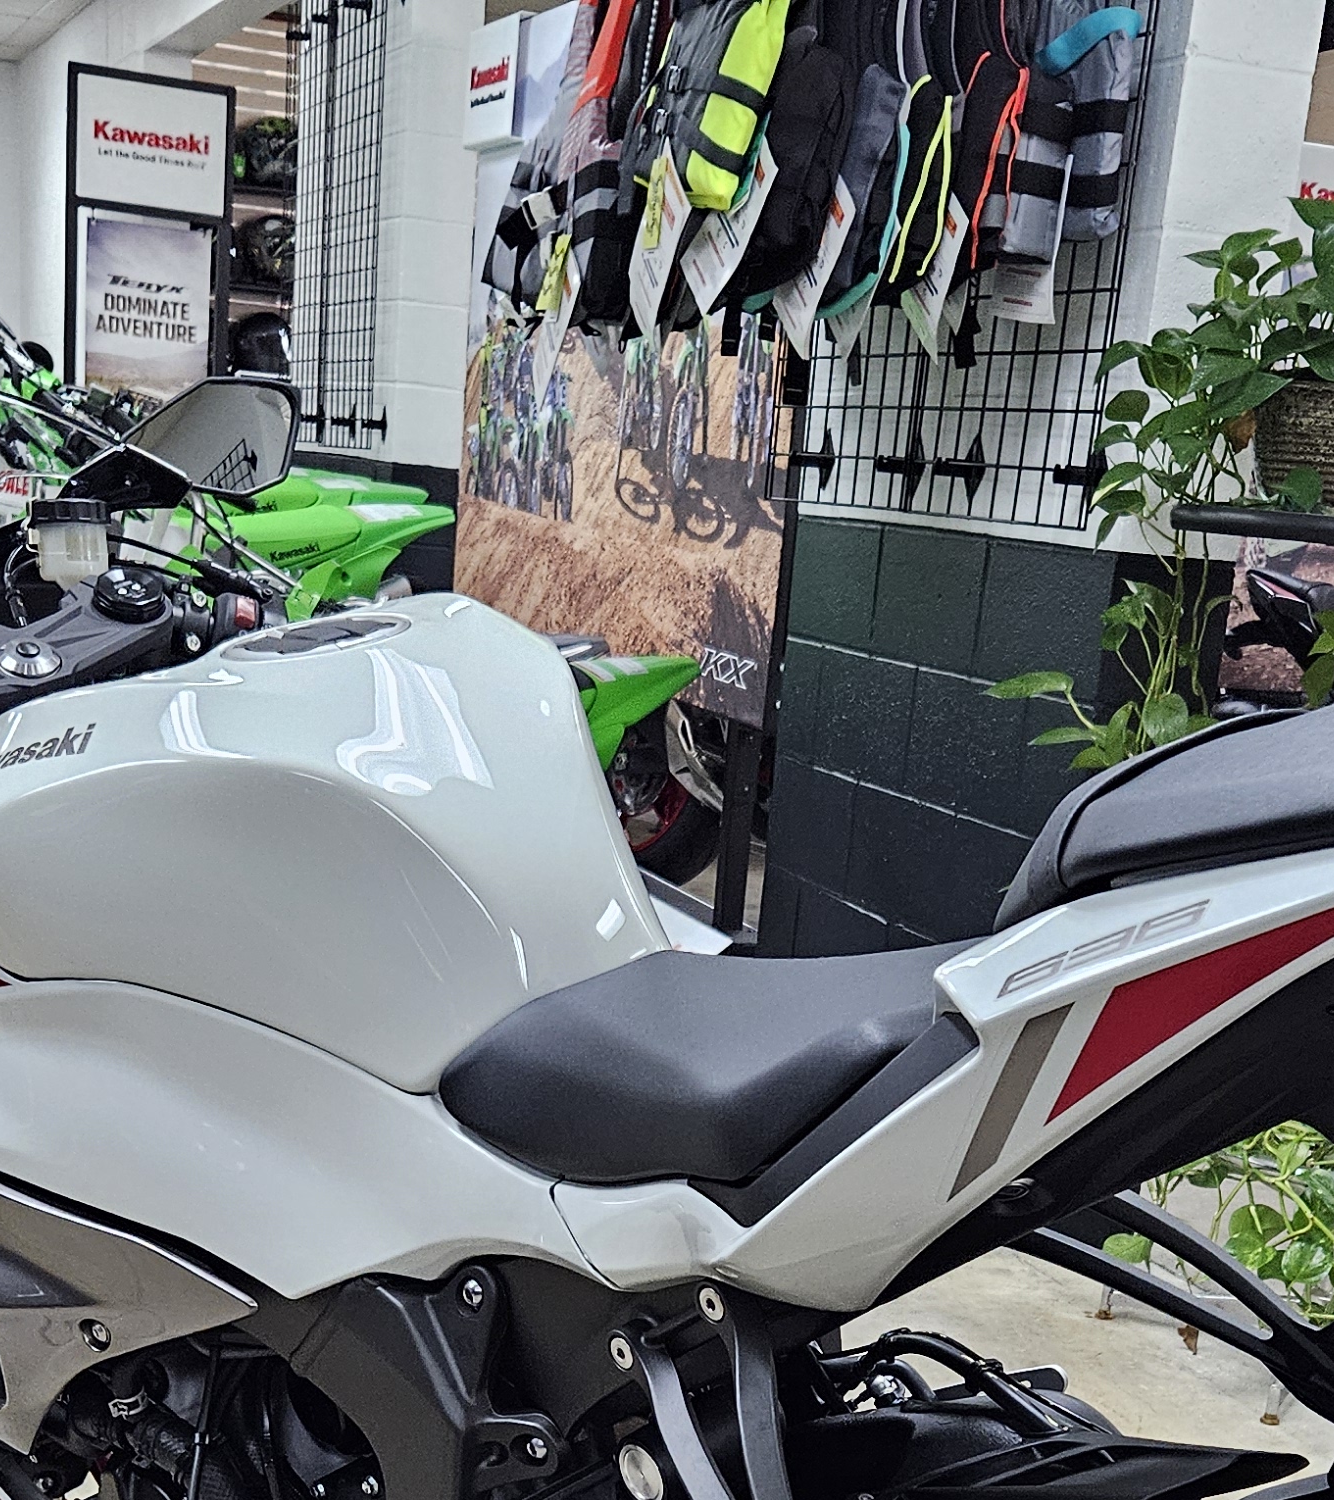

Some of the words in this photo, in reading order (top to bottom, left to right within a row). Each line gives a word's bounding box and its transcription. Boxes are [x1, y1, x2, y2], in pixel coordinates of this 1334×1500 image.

[93, 119, 210, 156] Kawasaki
[98, 147, 113, 156] Let
[115, 149, 130, 159] the
[132, 151, 156, 164] Good
[103, 292, 191, 321] DOMINATE
[95, 314, 198, 344] ADVENTURE
[269, 541, 321, 563] Kawasaki
[699, 647, 756, 690] KX
